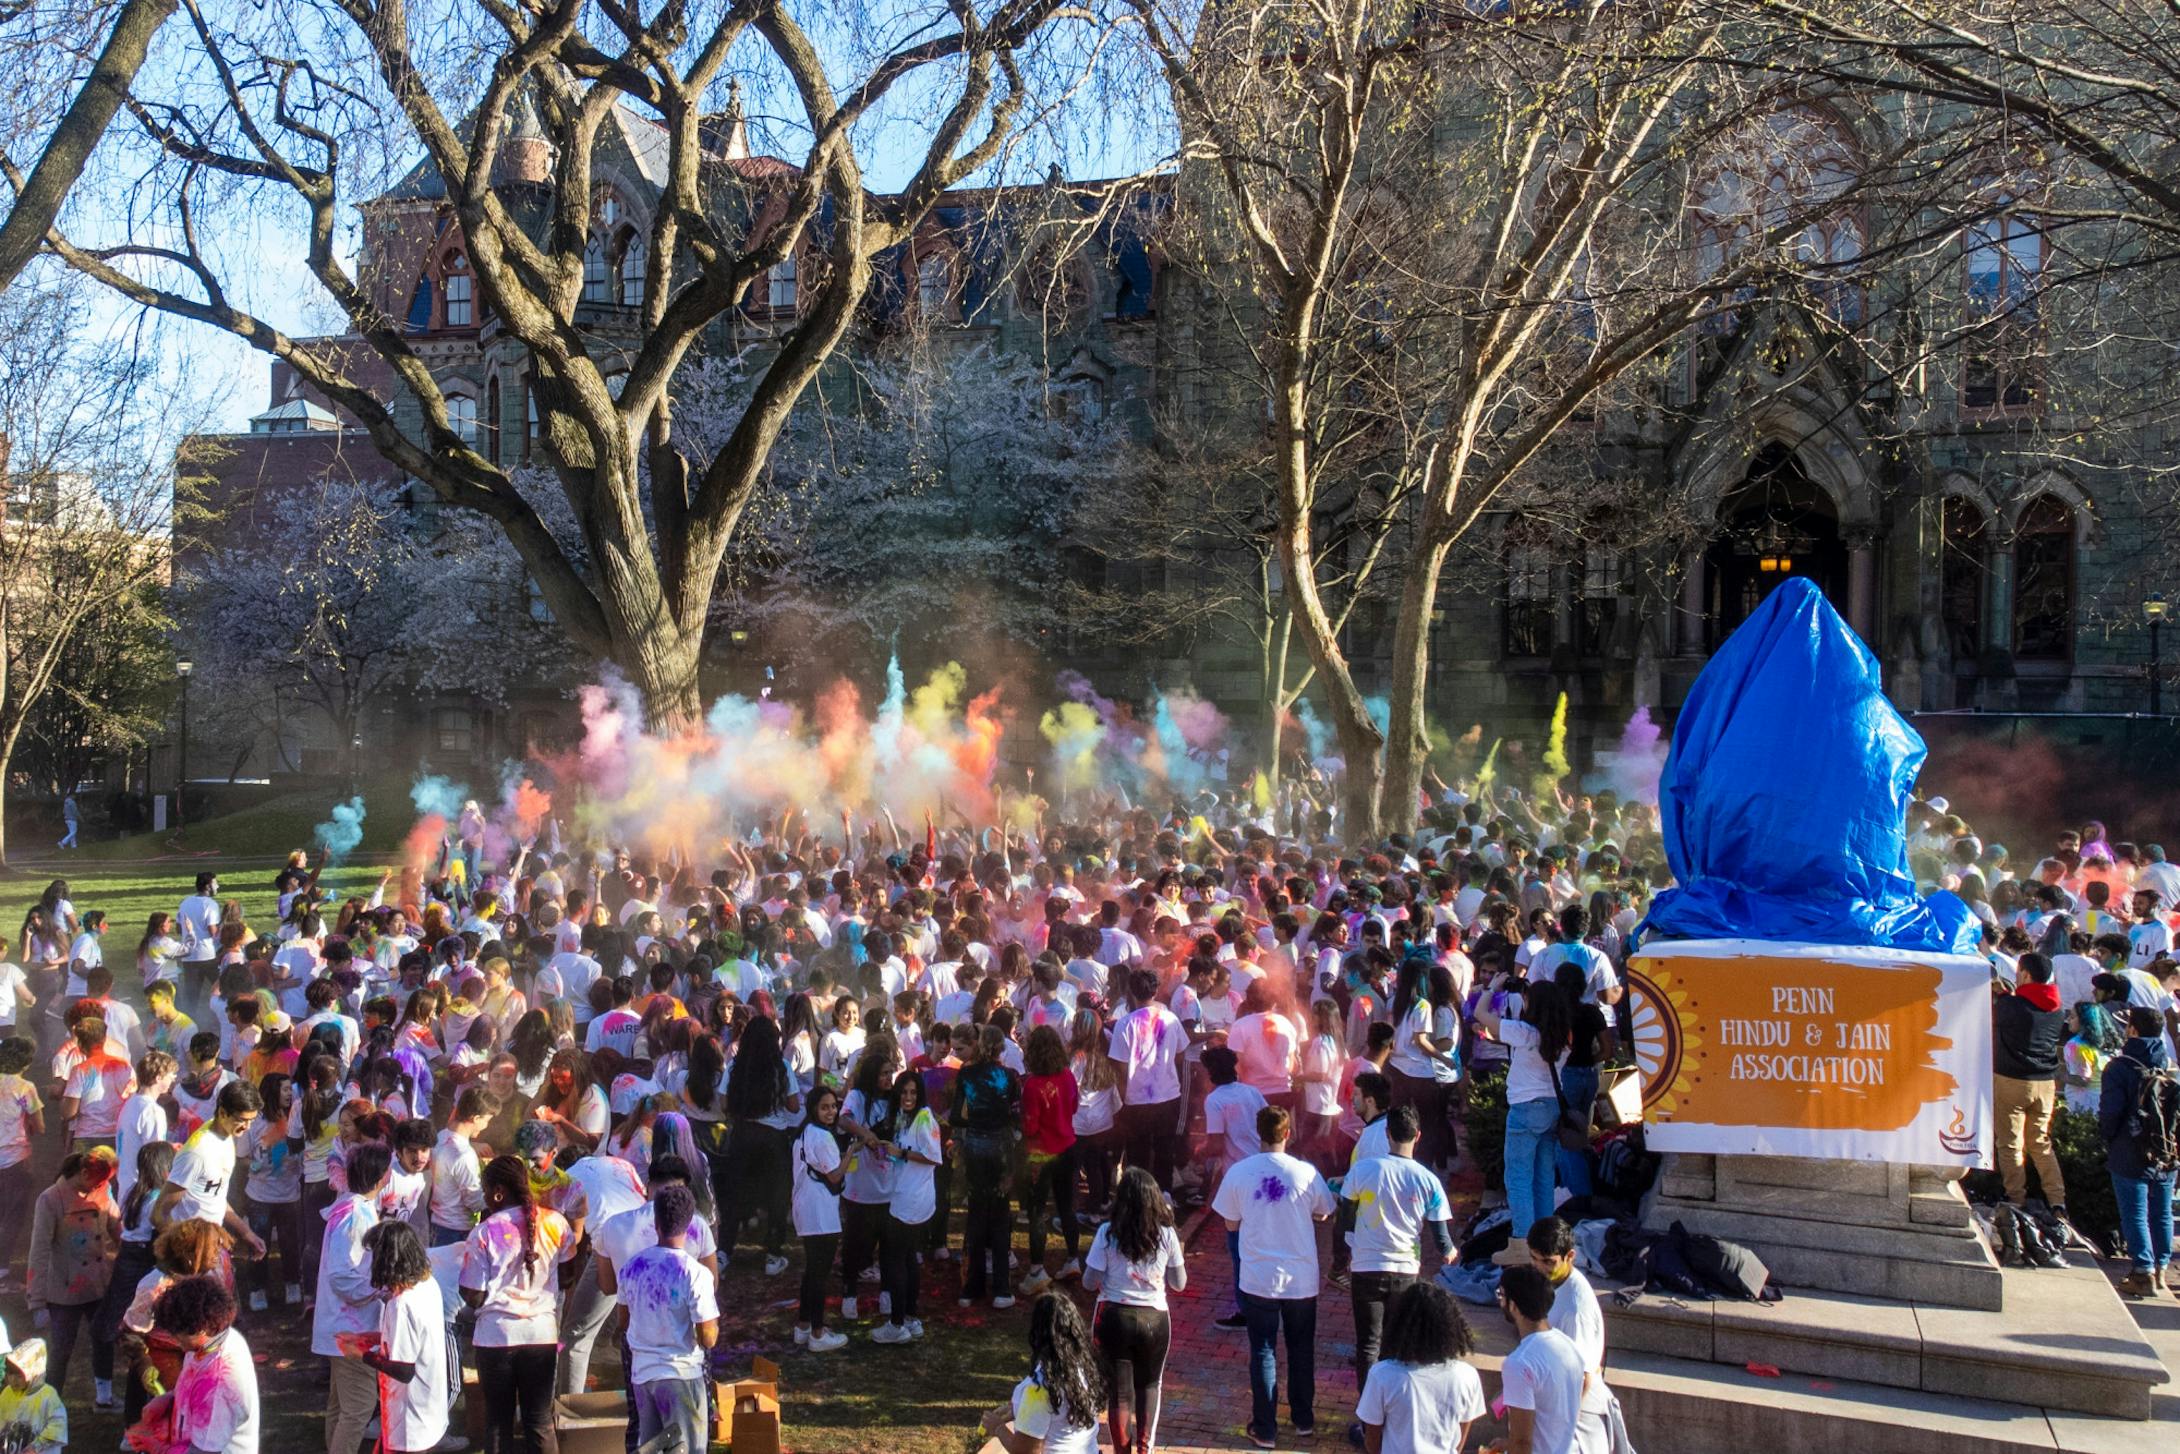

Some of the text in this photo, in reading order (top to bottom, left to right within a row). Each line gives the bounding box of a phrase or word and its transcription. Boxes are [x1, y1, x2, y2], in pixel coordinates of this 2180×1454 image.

[1771, 987, 1834, 1014] PENN
[1720, 1019, 1891, 1050] HINDU & JAIN
[1729, 1054, 1884, 1085] ASSOCIATION
